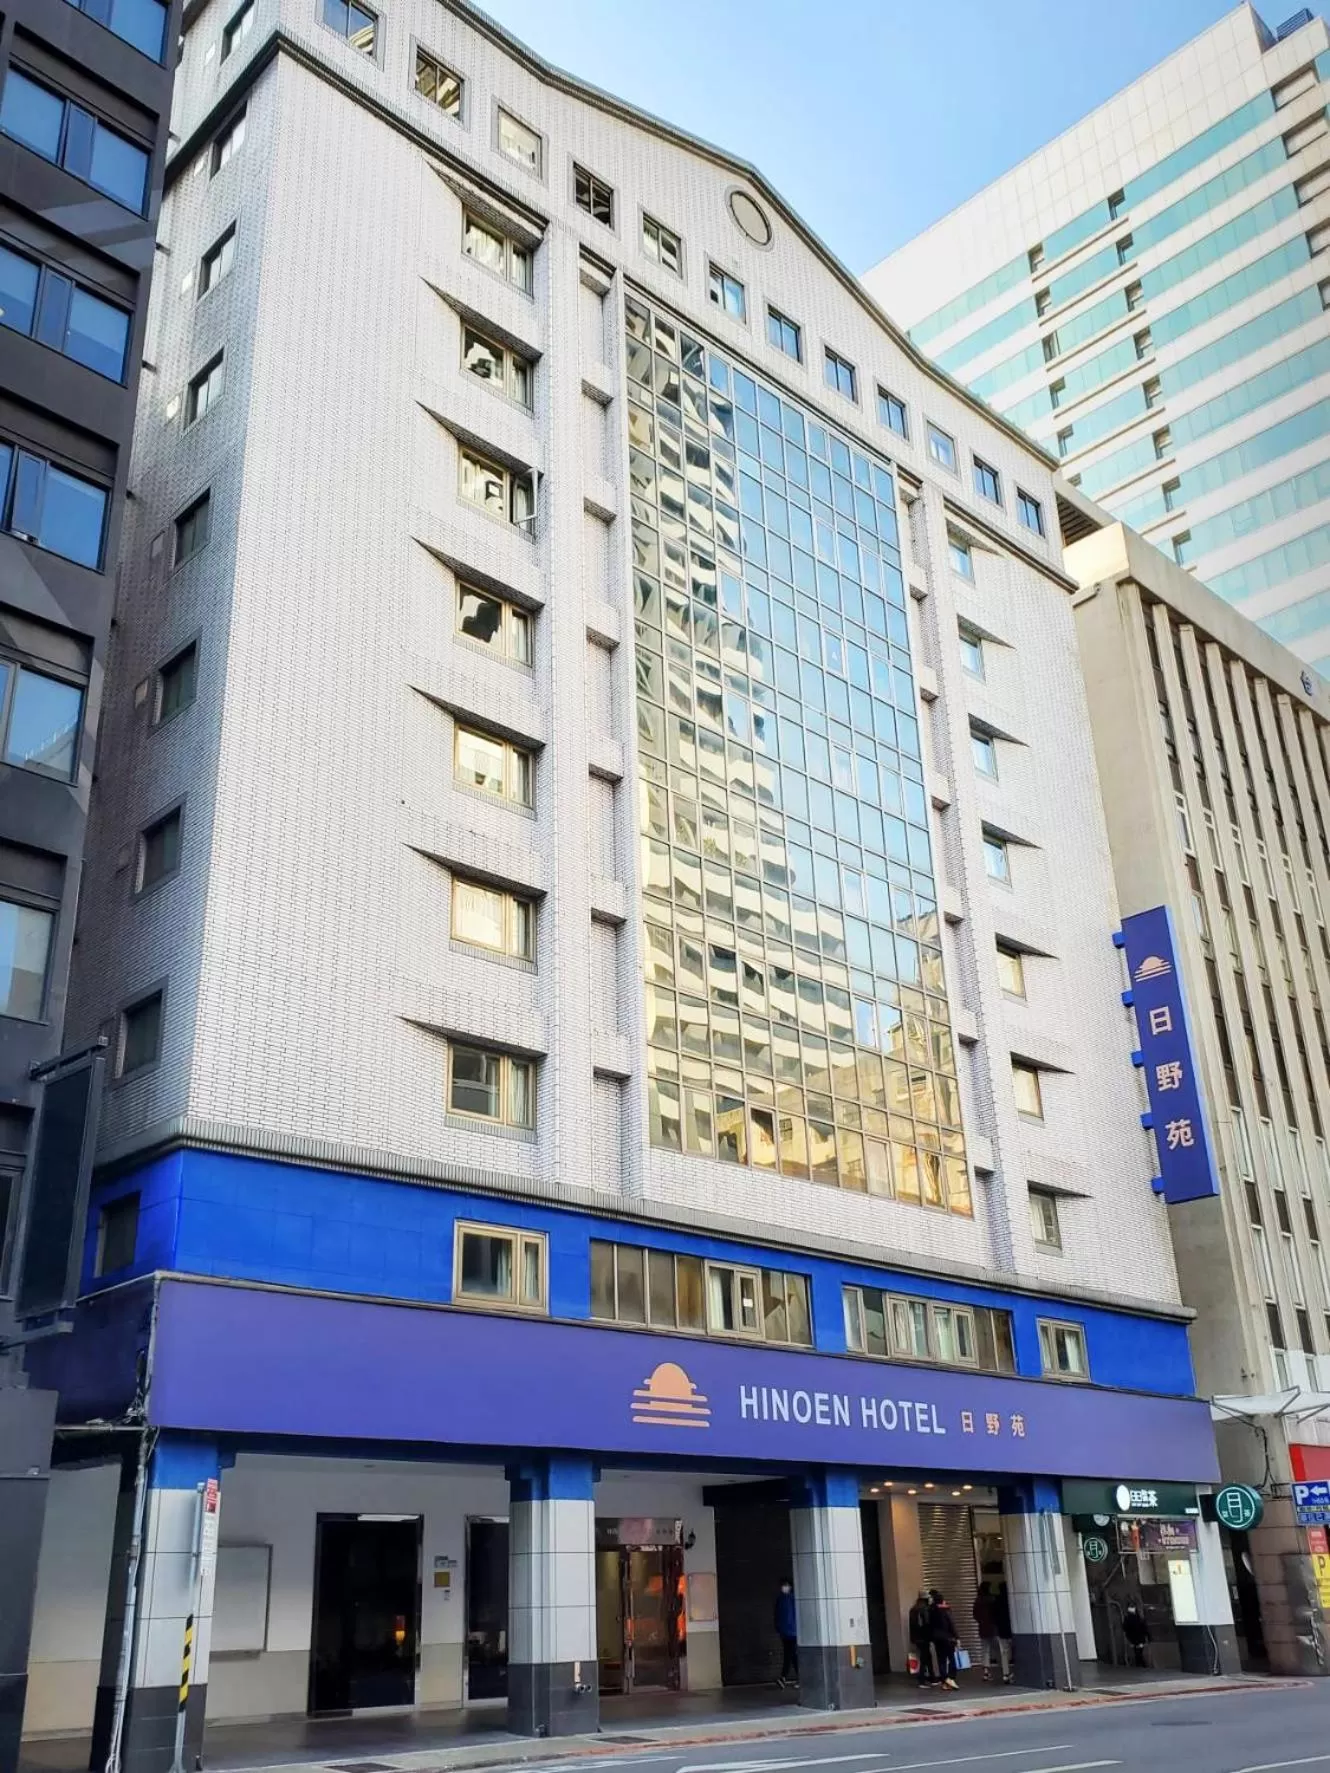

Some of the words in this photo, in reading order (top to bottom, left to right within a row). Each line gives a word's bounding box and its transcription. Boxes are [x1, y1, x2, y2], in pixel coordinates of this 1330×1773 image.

[1149, 1005, 1195, 1150] 日野苑
[740, 1385, 851, 1427] HINOEN
[860, 1396, 947, 1435] HOTEL
[961, 1410, 1026, 1438] 日野苑
[1294, 1484, 1310, 1506] P
